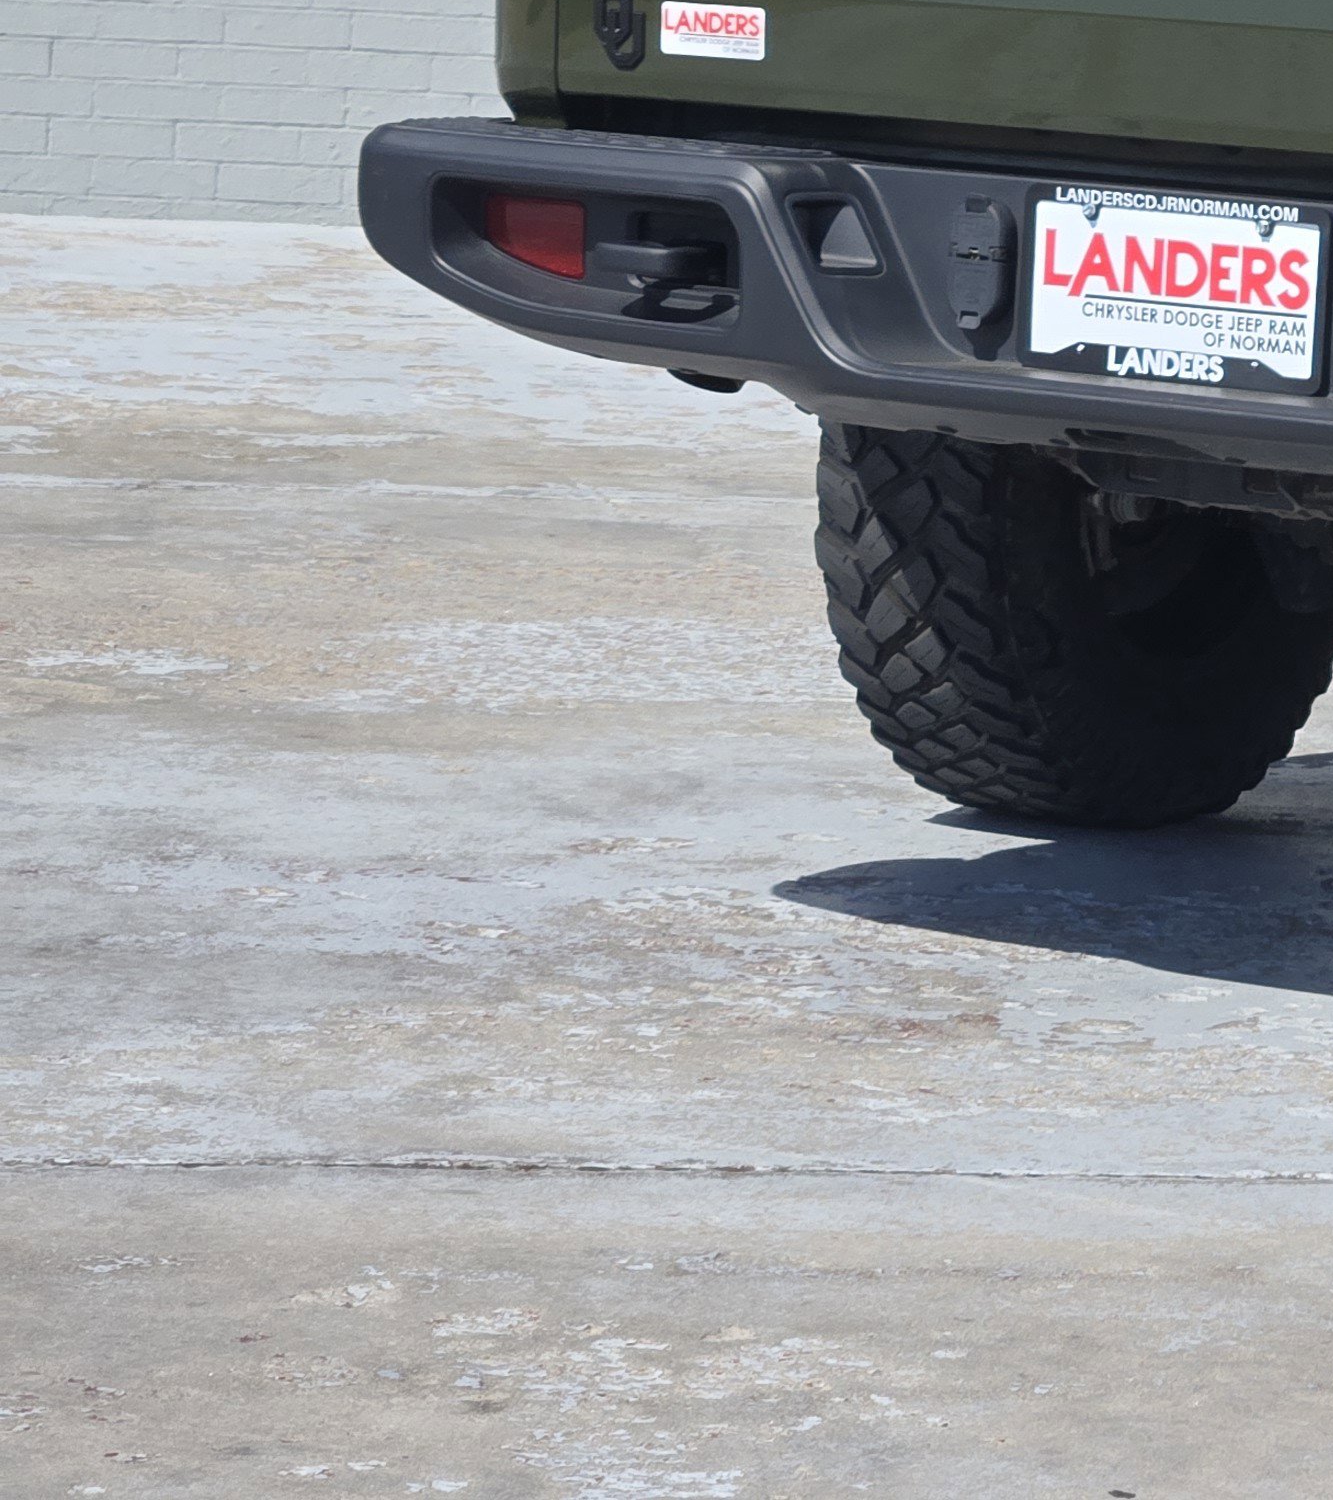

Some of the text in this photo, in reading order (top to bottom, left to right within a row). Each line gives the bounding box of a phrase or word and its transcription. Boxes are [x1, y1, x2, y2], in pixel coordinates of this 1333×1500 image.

[664, 8, 760, 37] LANDERS
[1056, 186, 1299, 222] LANDERSCDJRNORMAN.COM
[1043, 228, 1310, 311] LANDERS
[1082, 301, 1306, 337] CHRYSLER DODGE JEEP RAM
[1204, 332, 1306, 356] OF NORMAN
[1106, 345, 1224, 383] LANDERS
